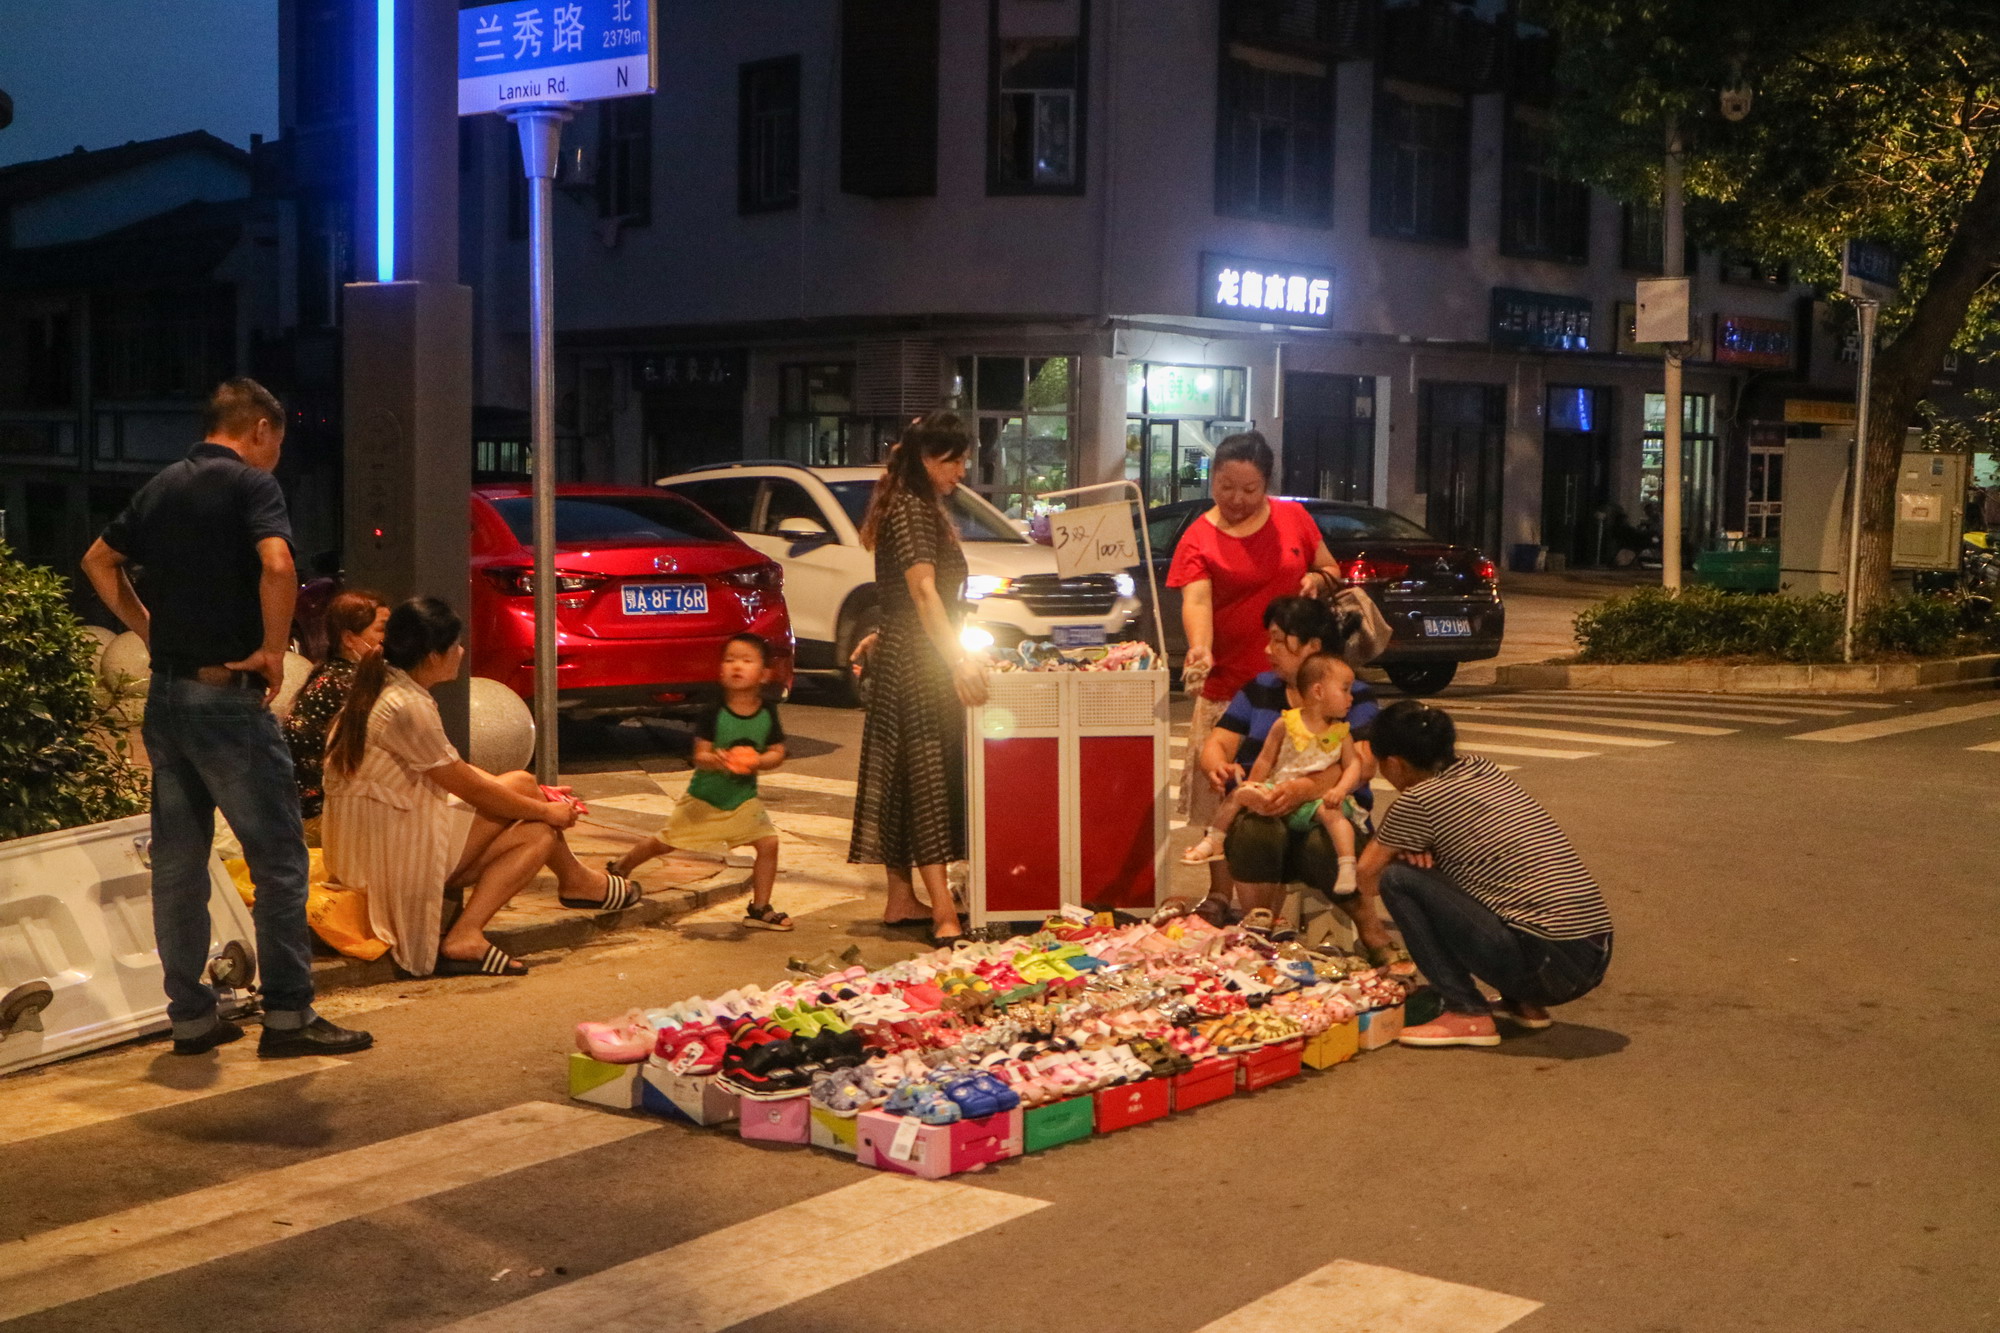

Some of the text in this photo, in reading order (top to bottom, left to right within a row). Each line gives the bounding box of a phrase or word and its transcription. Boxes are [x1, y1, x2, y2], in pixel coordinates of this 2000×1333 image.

[612, 0, 632, 22] 北
[475, 3, 585, 62] 兰秀路
[602, 28, 641, 48] 2379m
[617, 65, 628, 88] N
[499, 77, 569, 100] Lanxiu Rd.
